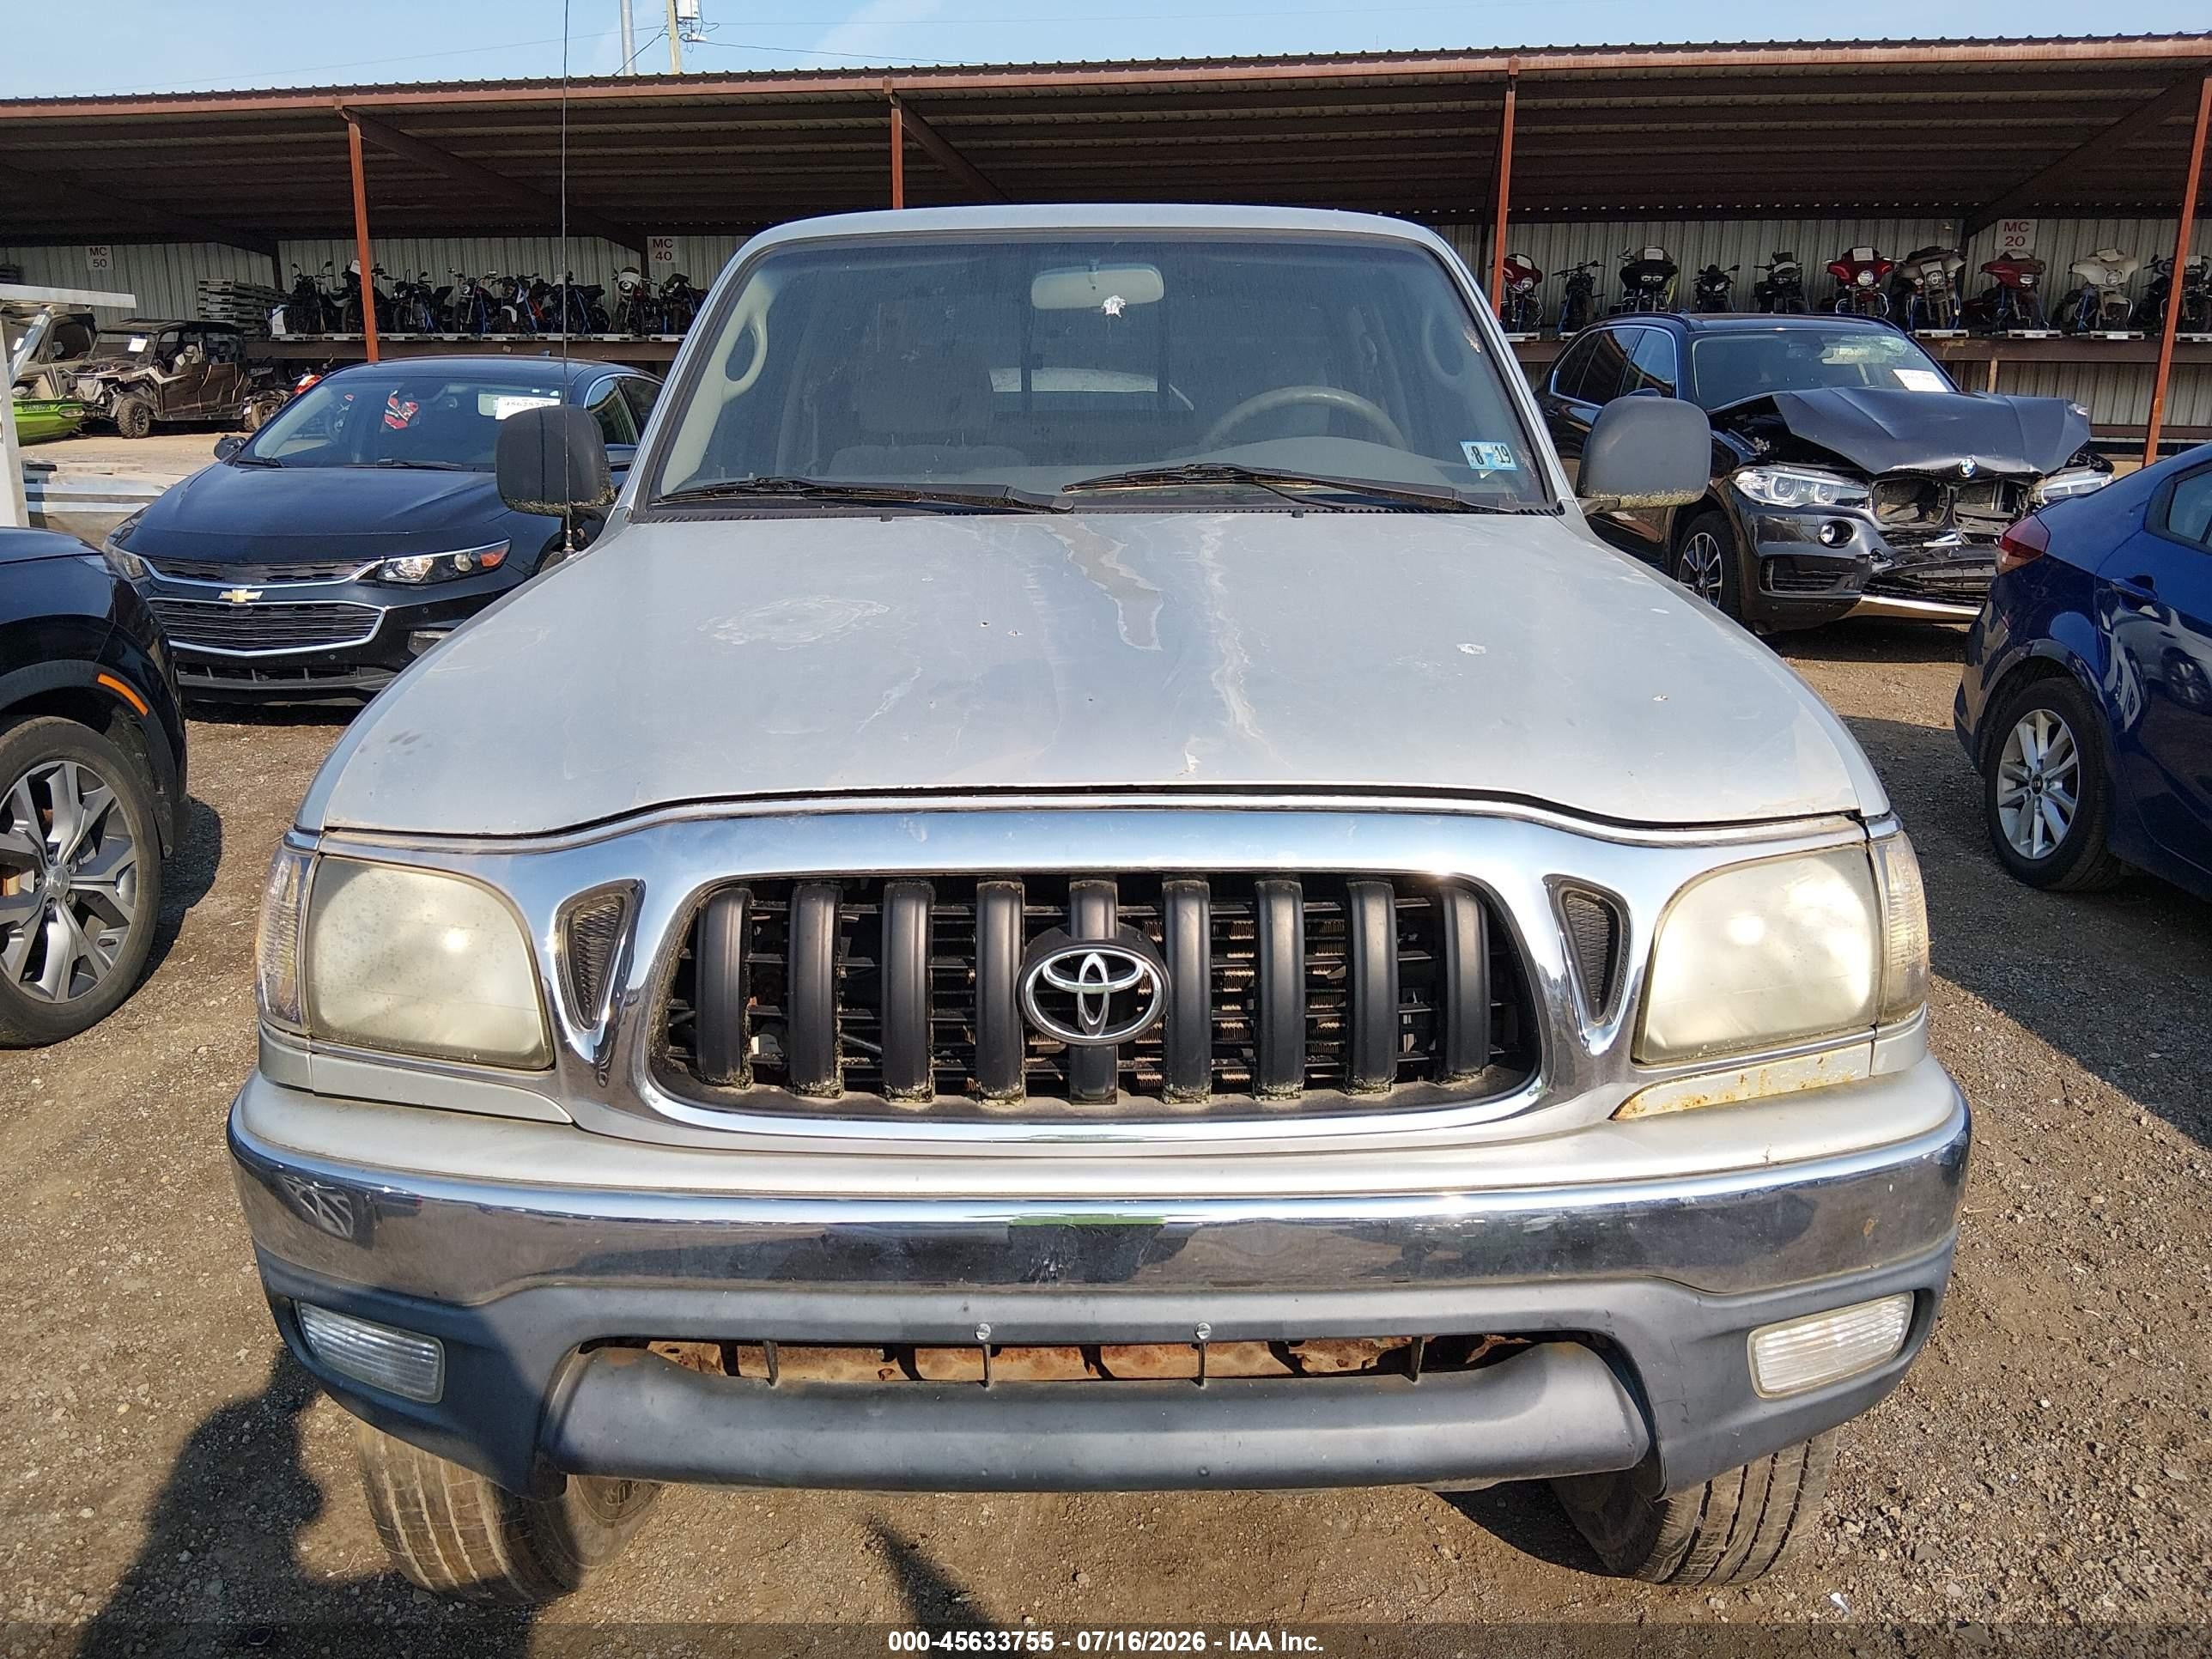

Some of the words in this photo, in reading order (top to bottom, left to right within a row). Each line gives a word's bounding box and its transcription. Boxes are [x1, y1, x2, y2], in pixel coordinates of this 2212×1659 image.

[2003, 221, 2030, 233] MC
[653, 238, 674, 249] MC
[2004, 235, 2026, 247] 20
[89, 246, 108, 257] MC
[655, 251, 672, 261] 40
[93, 258, 107, 268] 50
[1470, 446, 1485, 465] 8
[1494, 445, 1511, 464] 19
